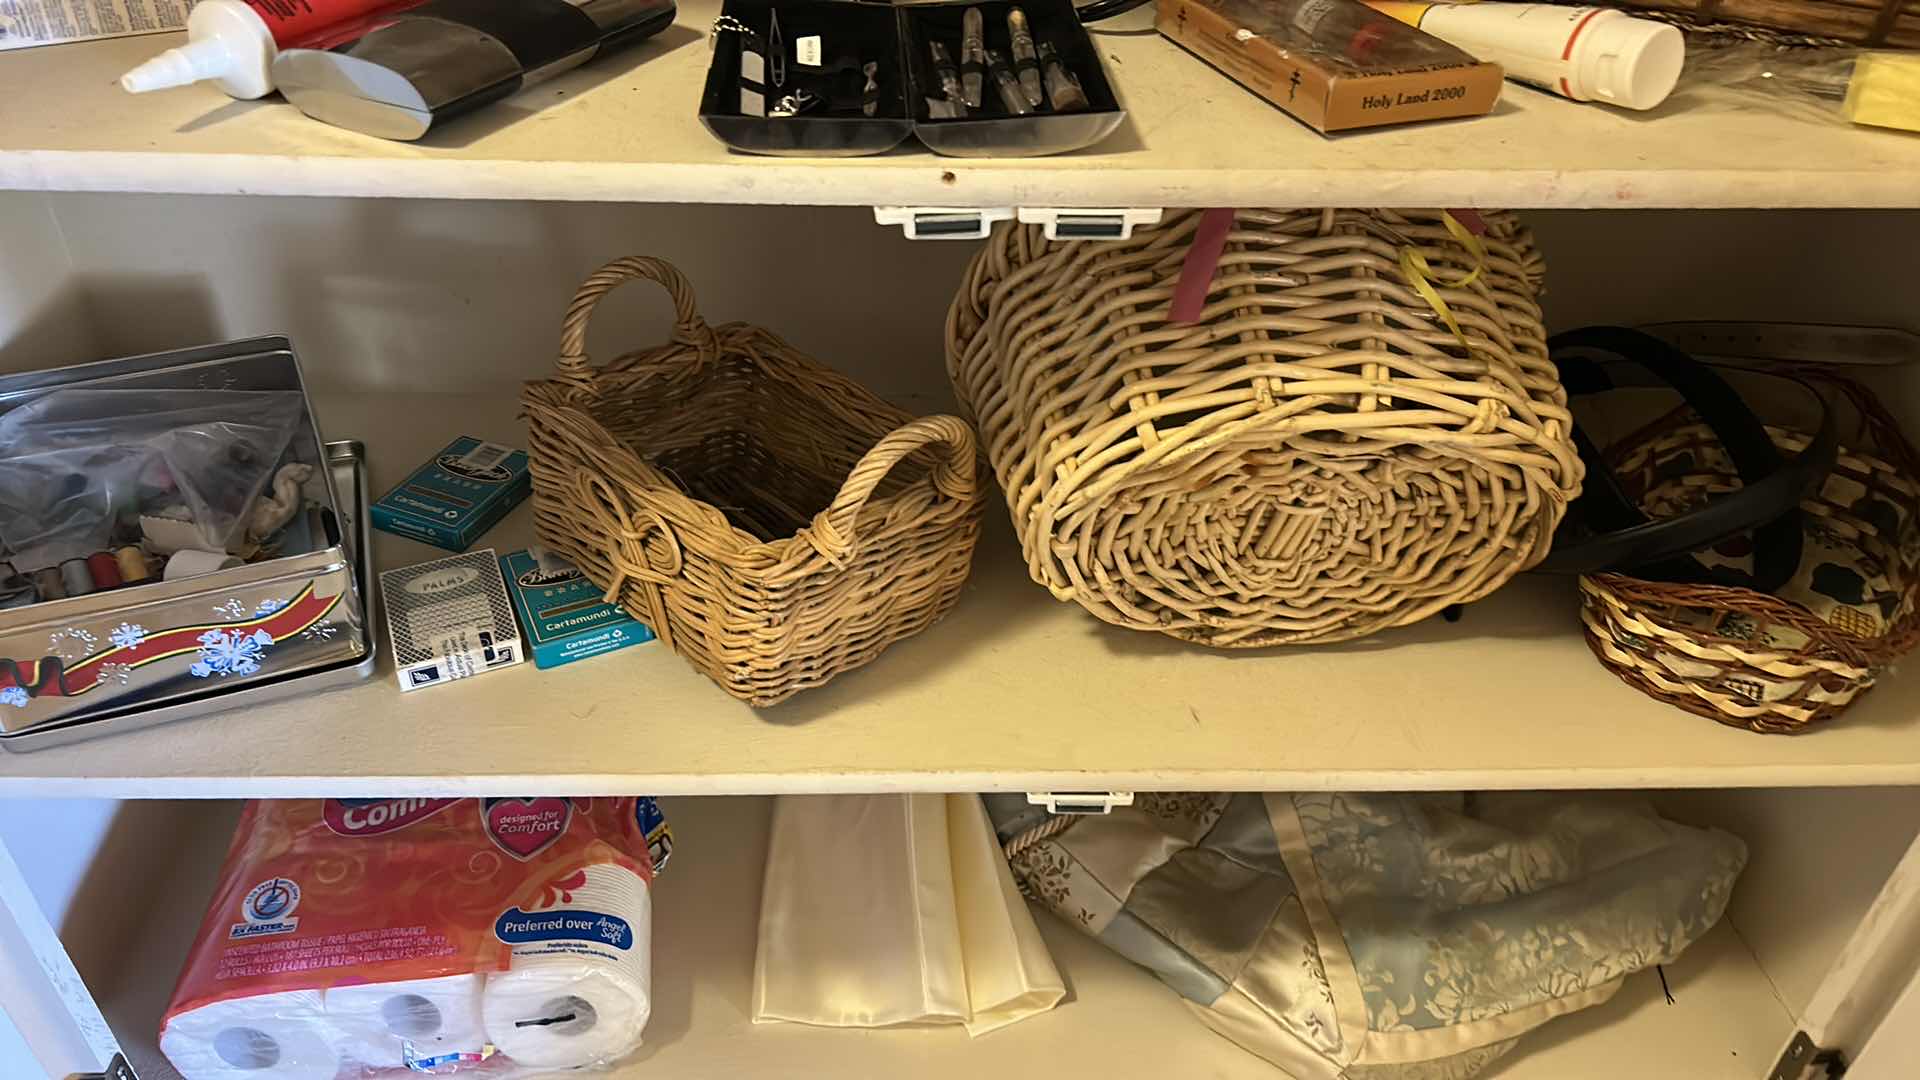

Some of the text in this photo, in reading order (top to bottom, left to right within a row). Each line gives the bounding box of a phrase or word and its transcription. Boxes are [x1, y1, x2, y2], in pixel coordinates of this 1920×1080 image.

[1361, 86, 1466, 109] Holy Land 2000
[422, 576, 465, 591] PALMS
[546, 609, 611, 631] Cartamundi
[566, 633, 610, 650] Cartamundi
[499, 810, 559, 825] designed for
[498, 819, 561, 834] Comfort
[504, 917, 594, 933] Preferred over
[595, 916, 627, 933] Angel
[600, 927, 622, 944] Soft
